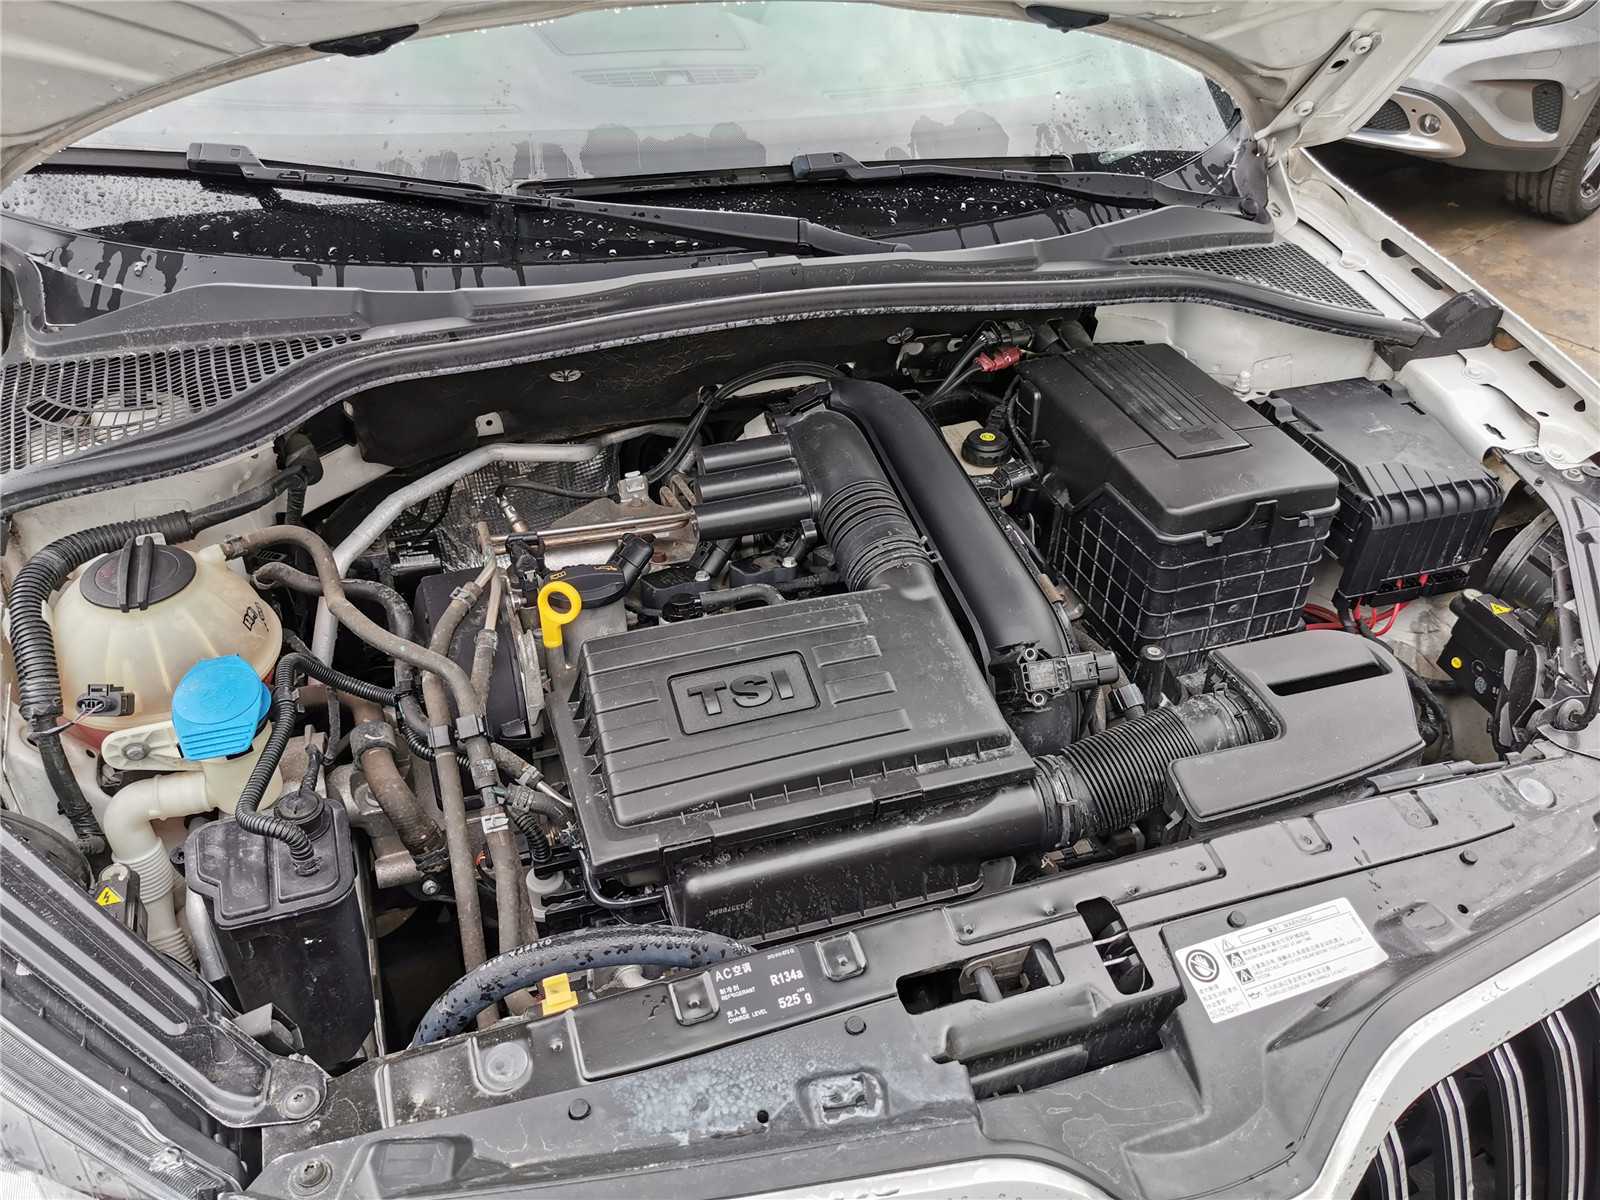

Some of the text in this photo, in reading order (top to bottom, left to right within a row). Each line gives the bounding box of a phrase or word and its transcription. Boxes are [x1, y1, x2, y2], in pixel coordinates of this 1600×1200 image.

[687, 669, 795, 716] TSI
[769, 968, 804, 986] R134a
[777, 992, 813, 1009] 525 g
